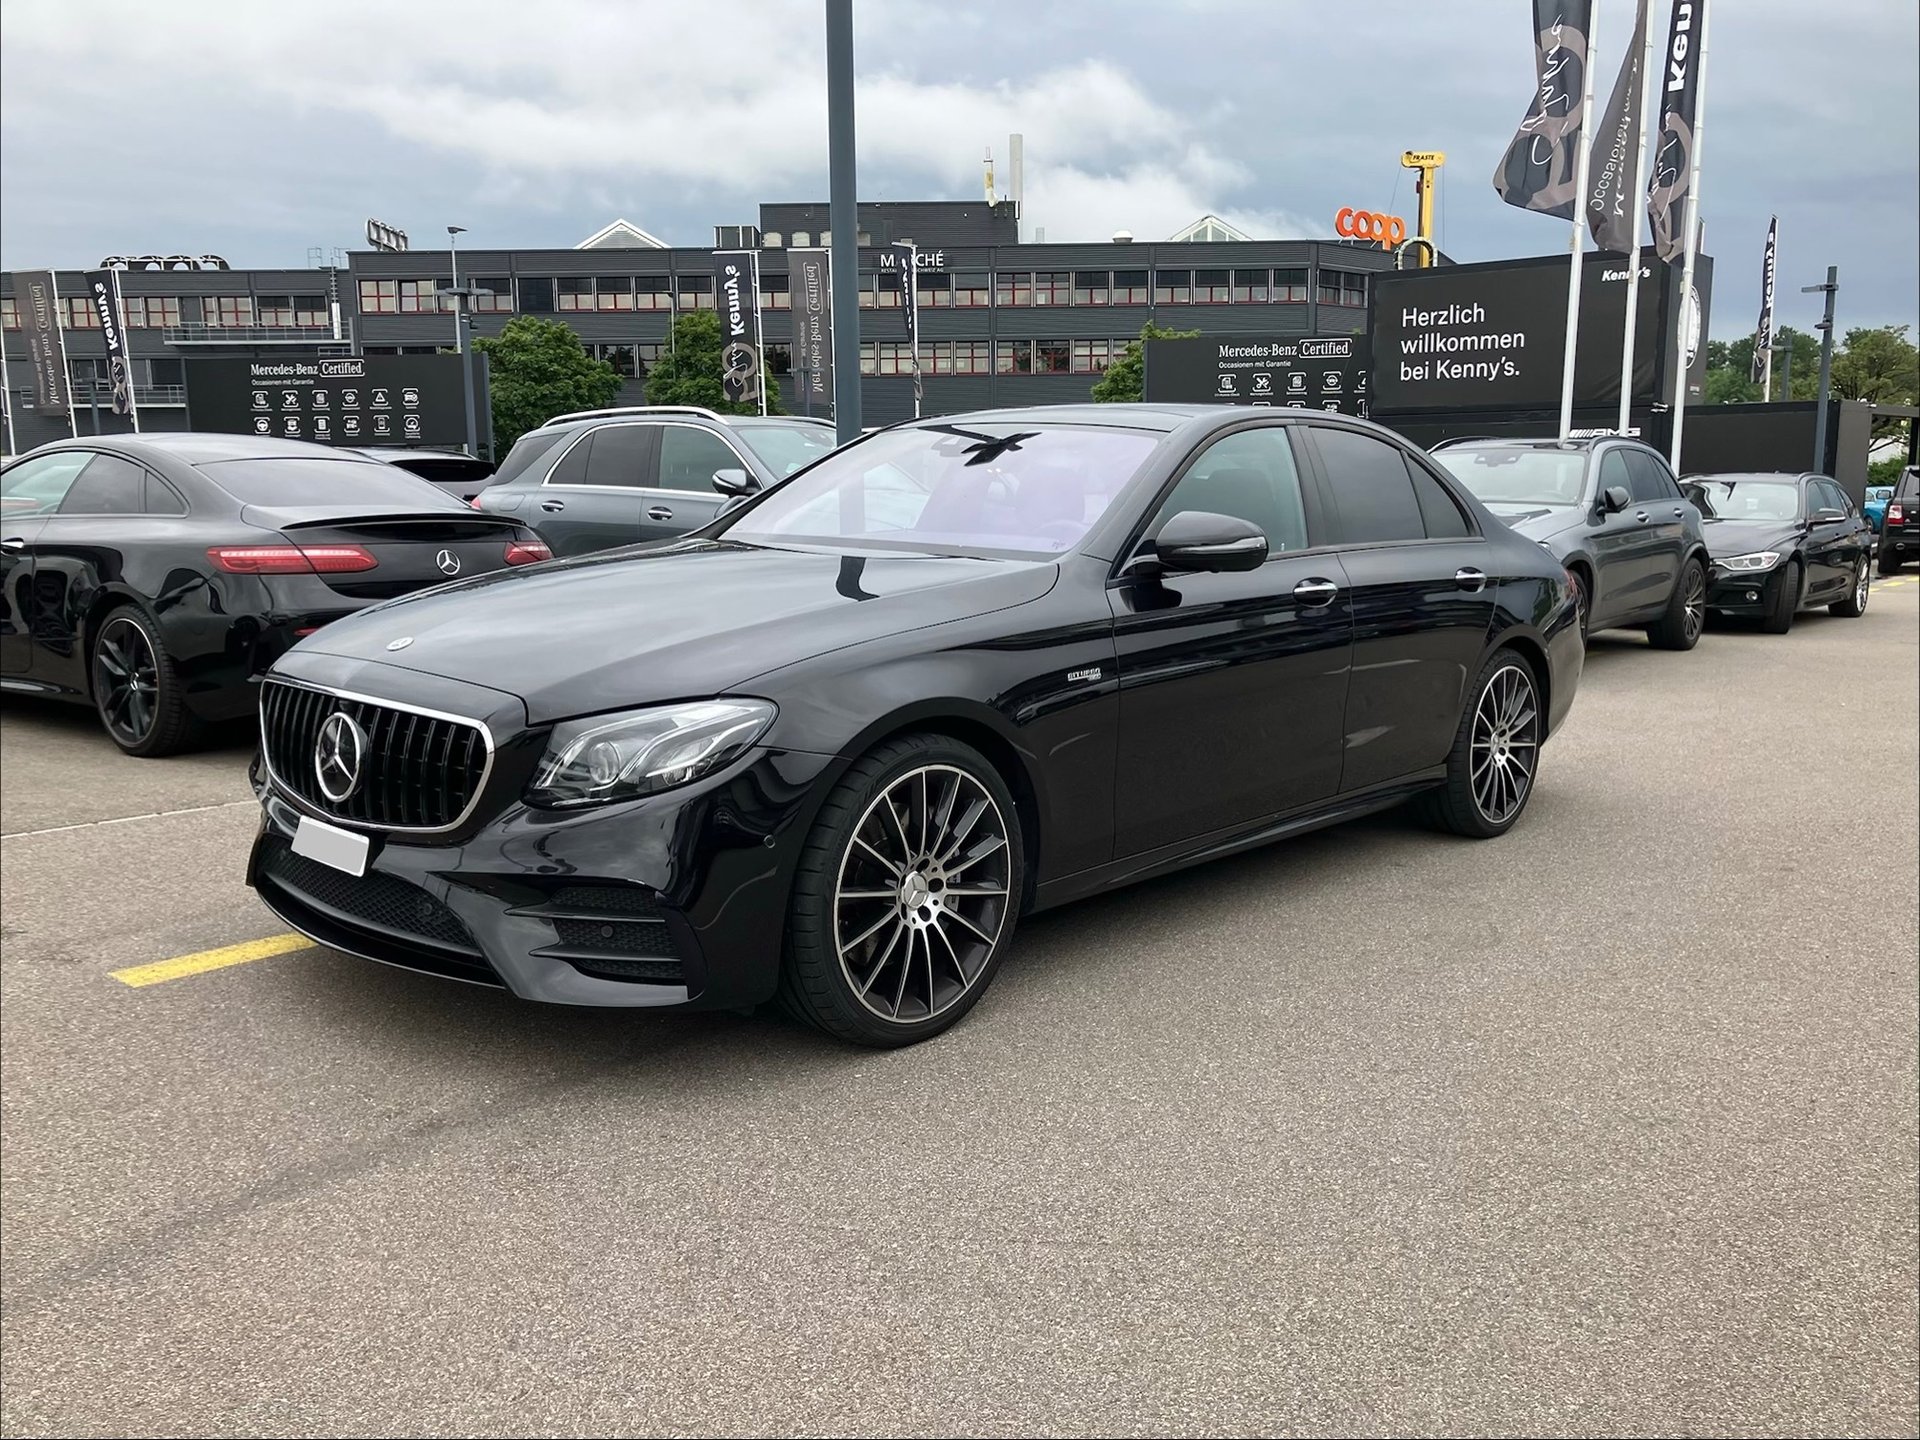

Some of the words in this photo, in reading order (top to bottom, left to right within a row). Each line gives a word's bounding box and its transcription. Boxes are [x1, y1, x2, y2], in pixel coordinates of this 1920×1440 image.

[1335, 207, 1406, 250] coop
[881, 250, 944, 267] MCHÉ
[1402, 302, 1485, 327] Herzlich
[1219, 343, 1297, 358] Mercedes-Benz
[1302, 341, 1349, 356] Certified
[1400, 332, 1525, 354] willkommen
[250, 363, 319, 376] Mercedes-Benz
[322, 362, 362, 375] Certified
[1219, 361, 1254, 369] Occasionen
[1266, 360, 1292, 368] Garantie
[1400, 360, 1429, 381] bei
[1436, 356, 1520, 381] Kenny's.
[251, 378, 284, 386] Occasionen
[292, 378, 315, 386] Garantie
